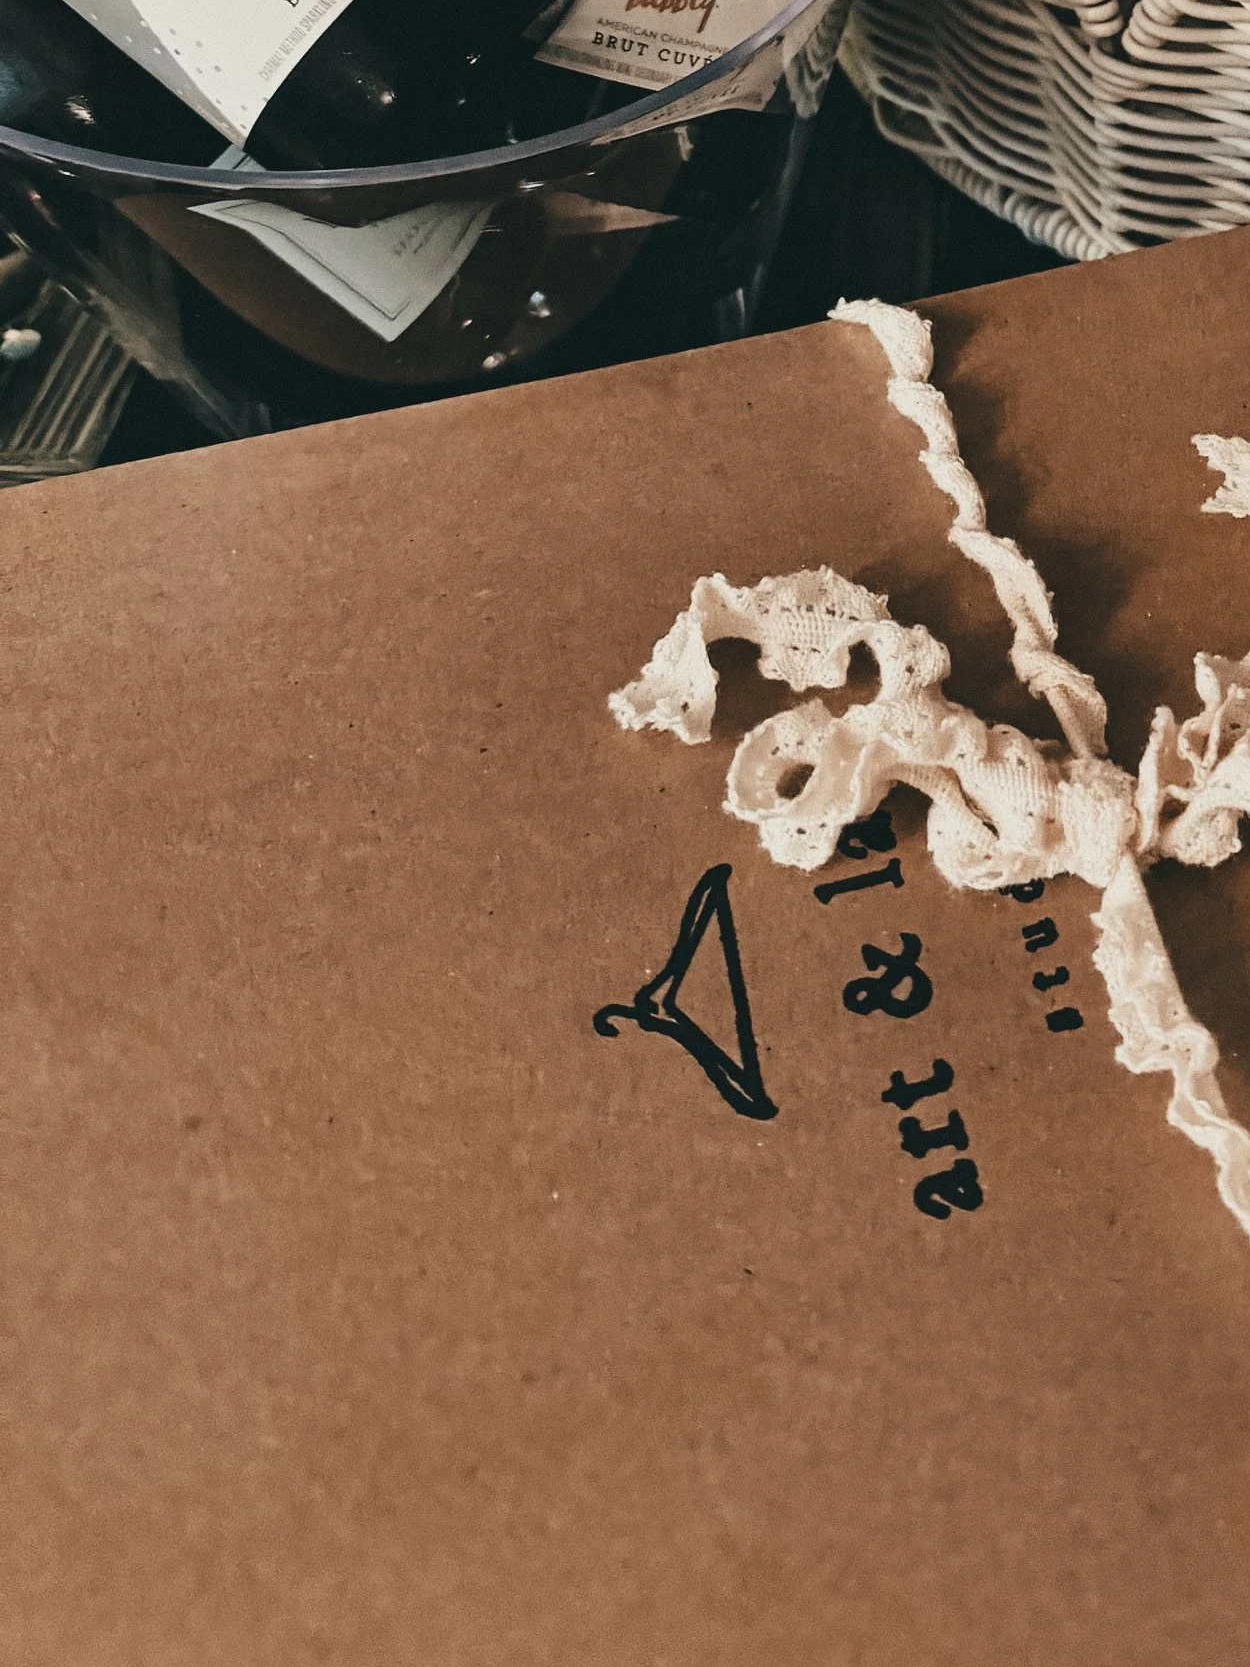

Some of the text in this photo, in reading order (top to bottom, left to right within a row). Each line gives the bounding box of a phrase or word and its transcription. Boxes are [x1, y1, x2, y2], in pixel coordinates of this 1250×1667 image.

[592, 31, 649, 57] BRUT
[597, 17, 658, 40] AMERICAN
[841, 932, 934, 1019] &
[881, 1058, 984, 1220] art
